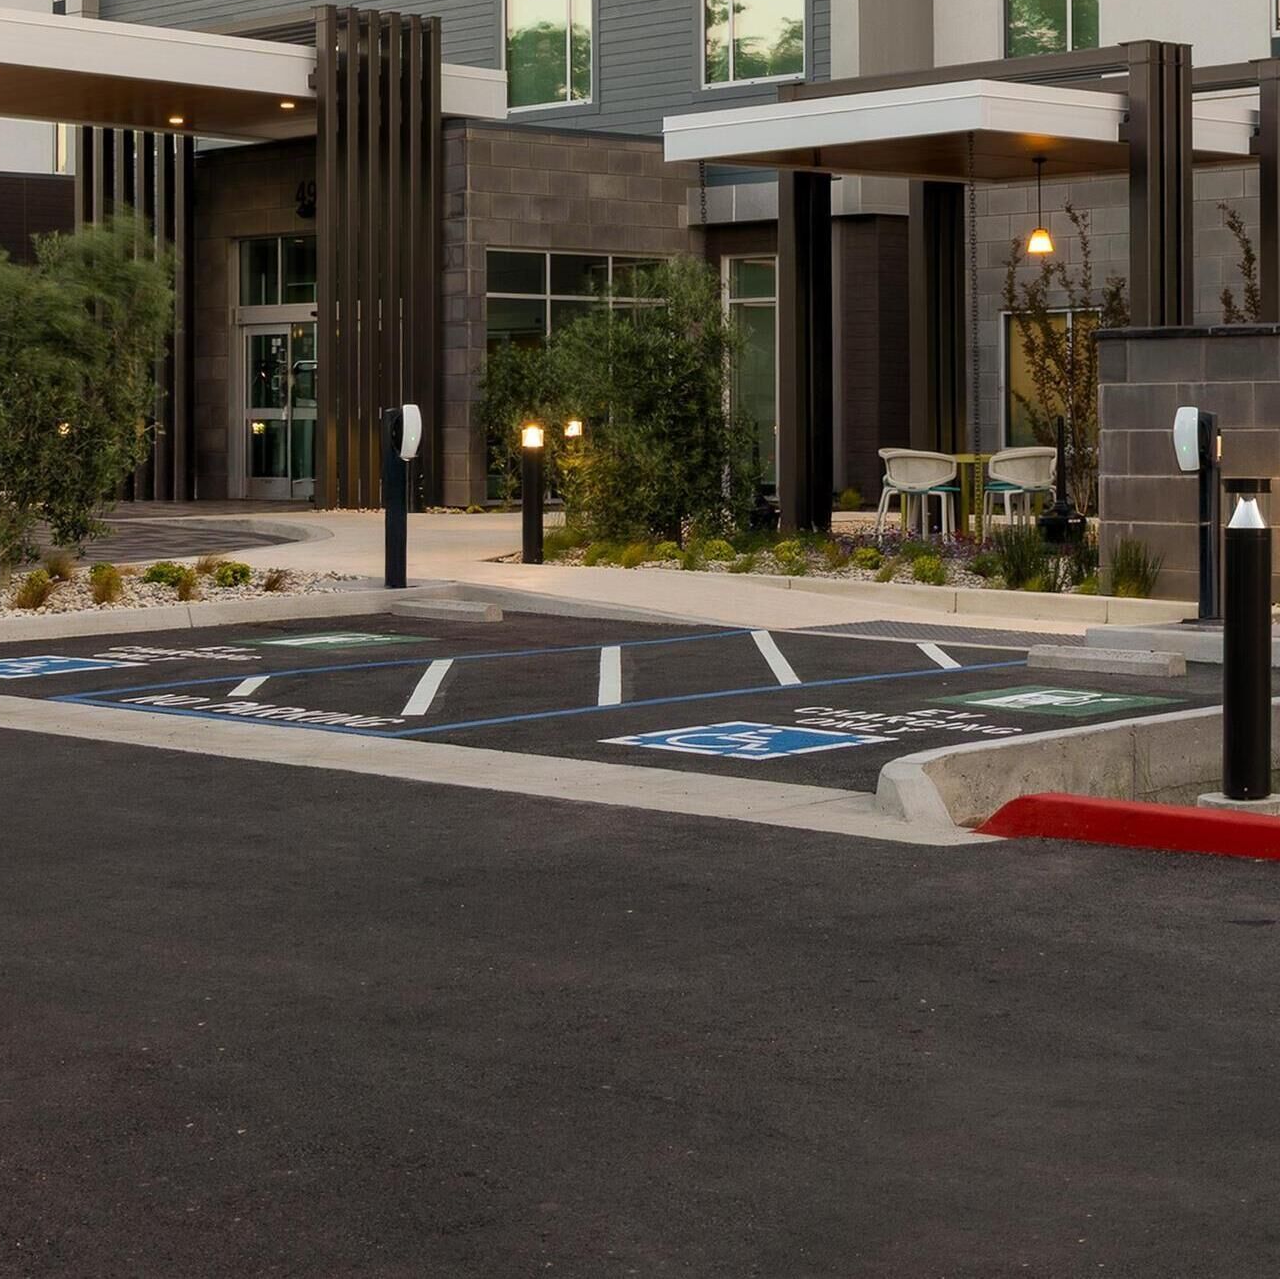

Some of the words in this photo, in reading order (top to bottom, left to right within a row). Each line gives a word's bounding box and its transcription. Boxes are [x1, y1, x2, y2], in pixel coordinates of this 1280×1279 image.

[120, 693, 211, 706] NO
[192, 700, 406, 728] PARKING
[793, 706, 1024, 735] CHARGING
[906, 708, 987, 720] EV
[795, 717, 927, 734] ONLY
